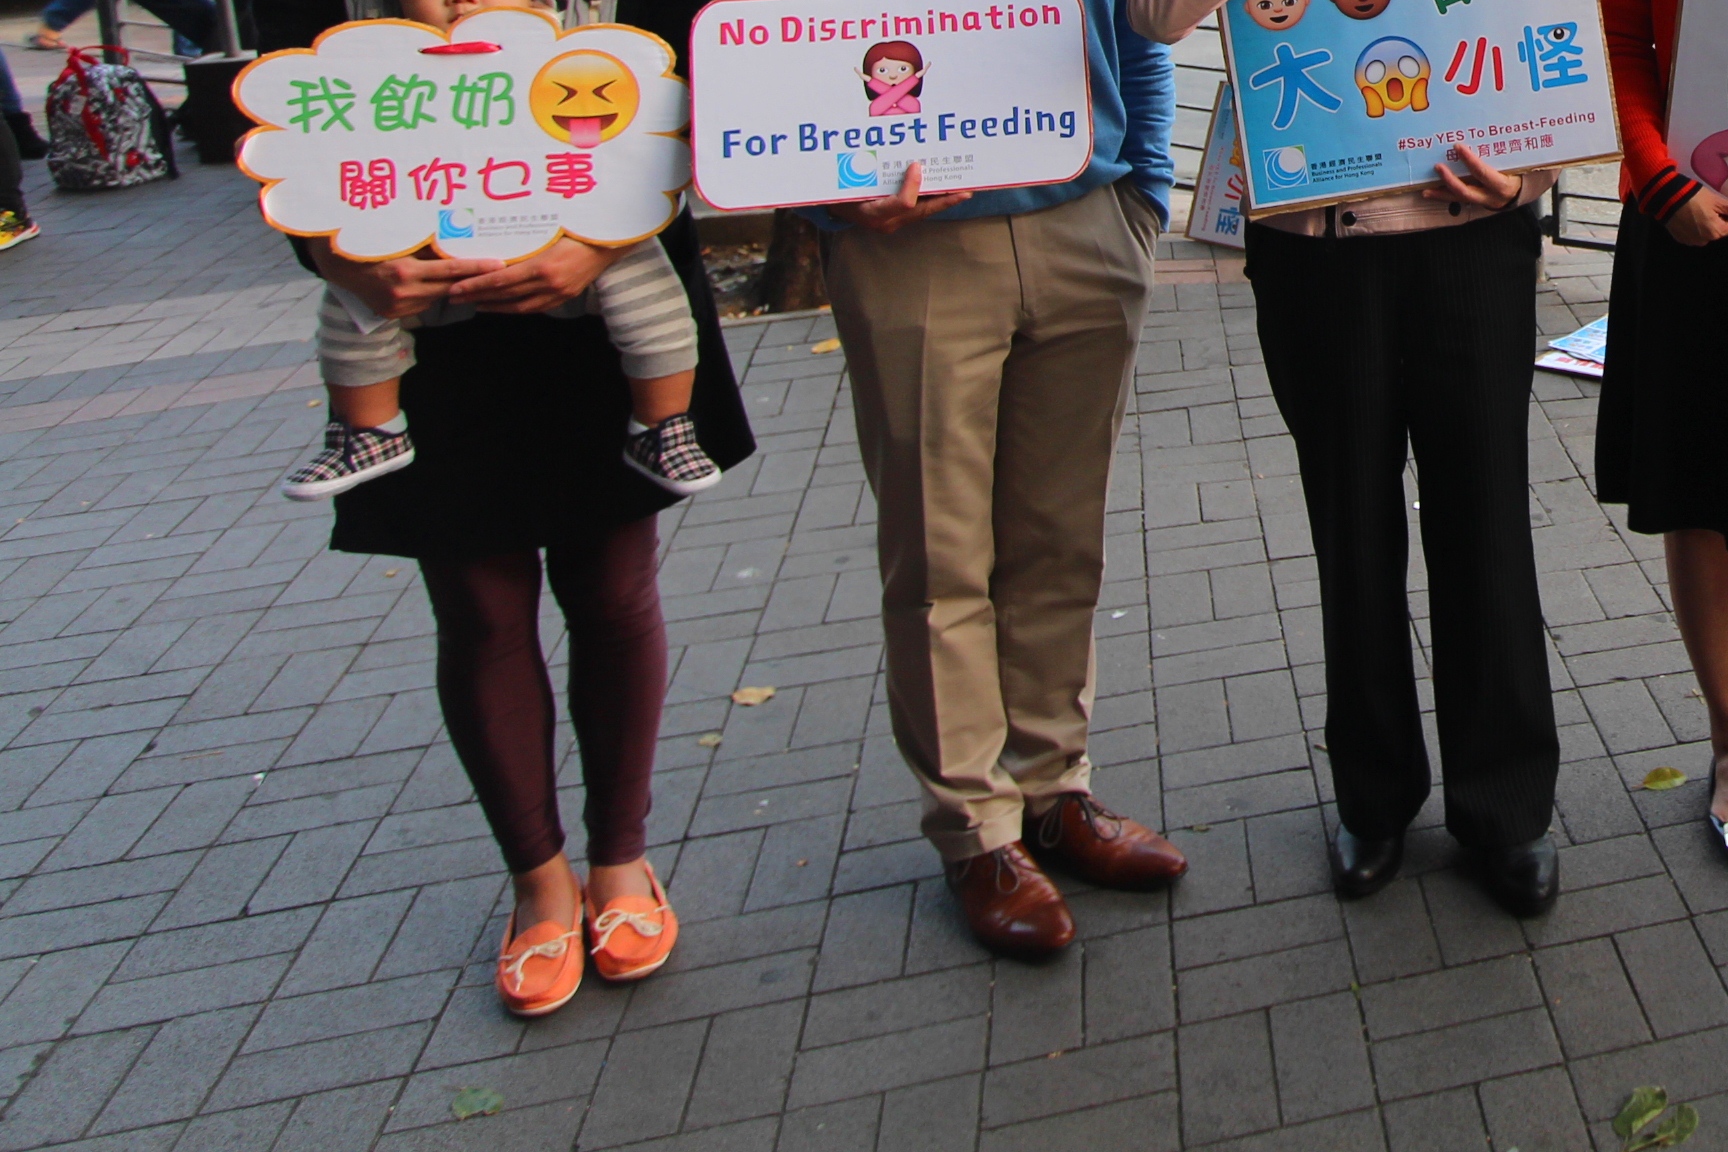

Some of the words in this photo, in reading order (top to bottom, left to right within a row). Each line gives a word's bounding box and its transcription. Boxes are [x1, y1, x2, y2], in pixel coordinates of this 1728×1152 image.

[719, 18, 769, 46] No
[781, 4, 1061, 43] Discrimination
[287, 72, 515, 133] 我飲奶
[1249, 41, 1344, 131] 大
[722, 129, 787, 158] For
[798, 117, 928, 152] Breast
[937, 106, 1076, 141] Feeding
[1398, 137, 1432, 150] #Say
[1436, 130, 1465, 143] YES
[1468, 128, 1485, 139] To
[1489, 112, 1596, 136] Breast-Feeding
[1446, 133, 1554, 162] 母育嬰齊和應
[340, 152, 597, 209] 關你乜事
